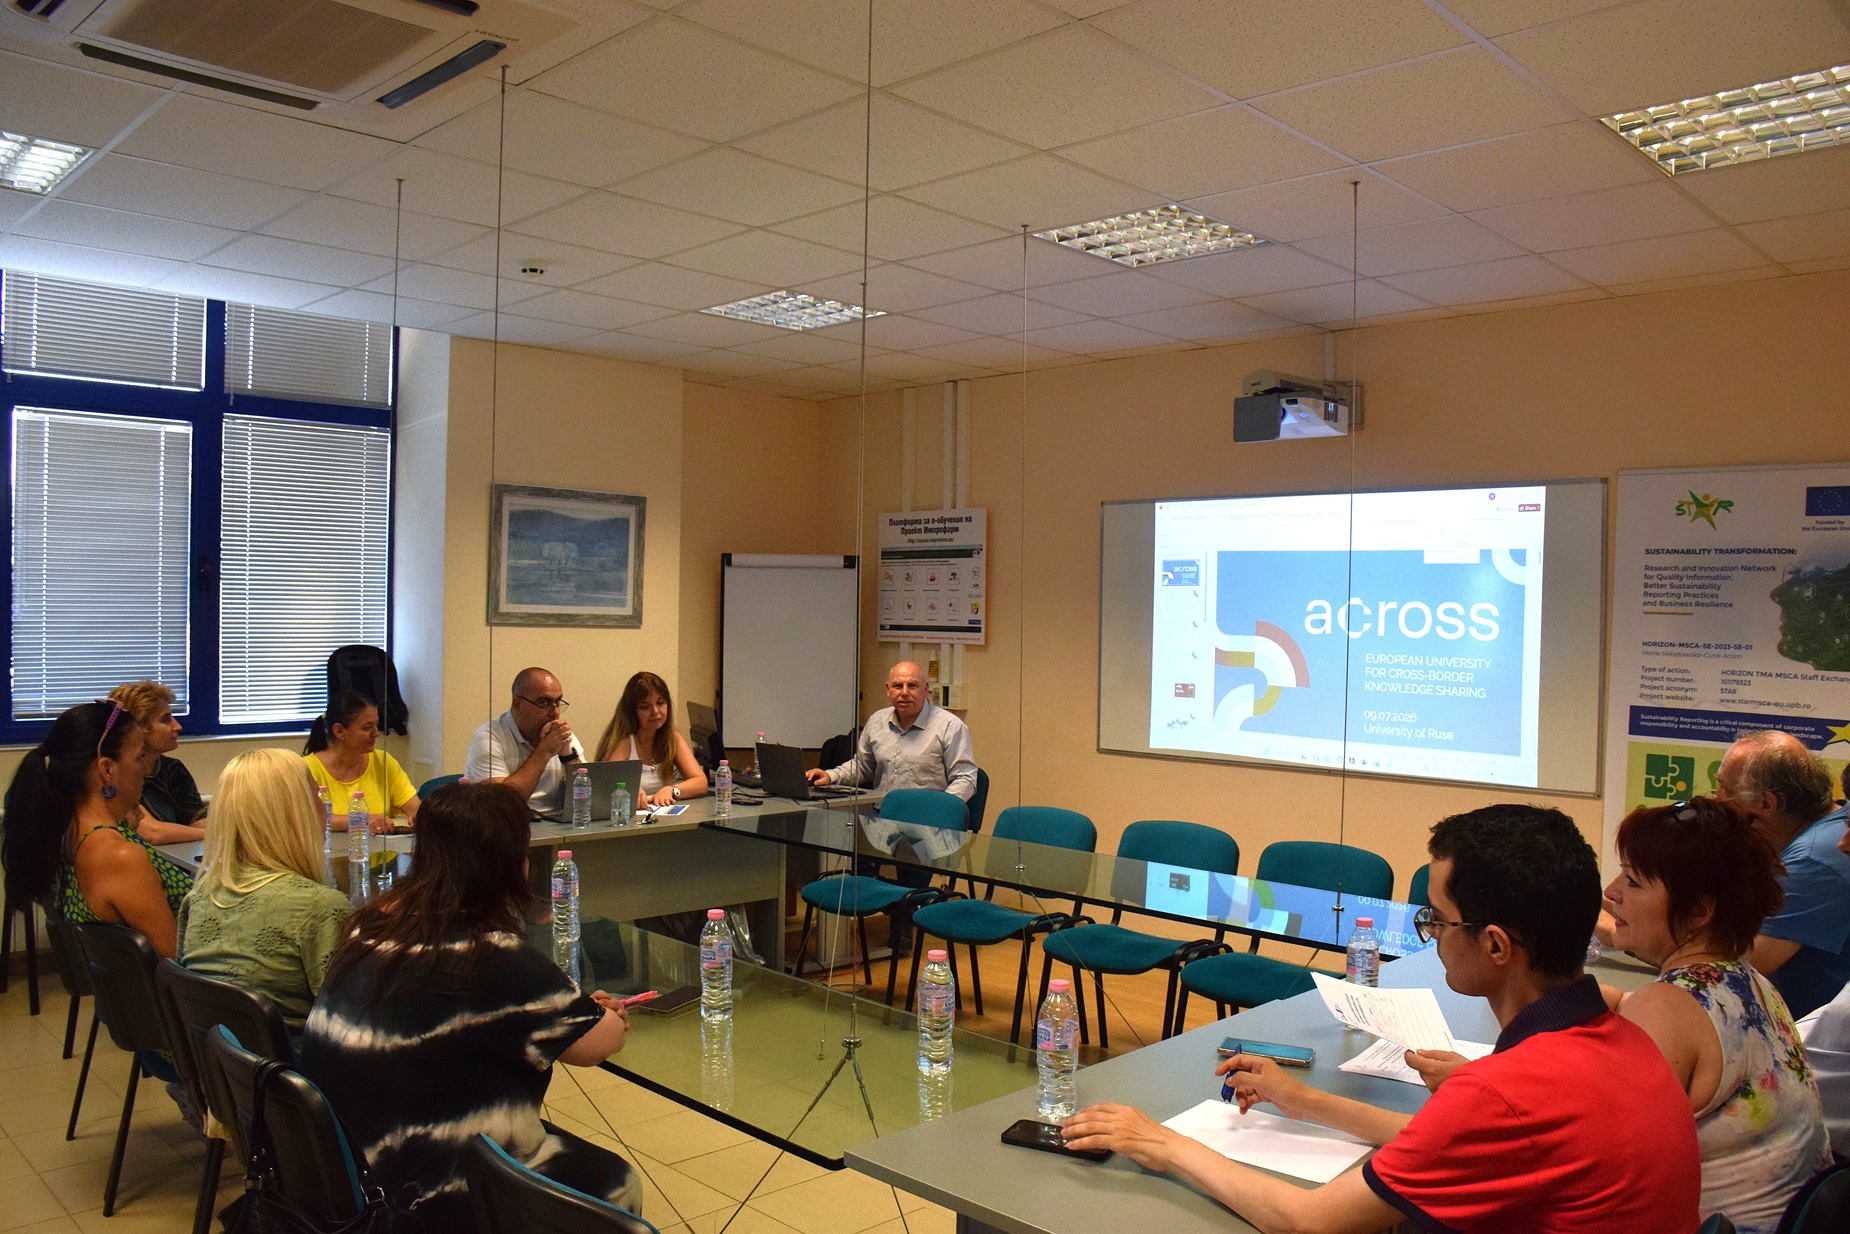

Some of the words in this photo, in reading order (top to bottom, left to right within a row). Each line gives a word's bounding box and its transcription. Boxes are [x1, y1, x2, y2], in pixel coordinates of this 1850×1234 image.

[1656, 574, 1683, 582] Quality
[1643, 591, 1681, 600] Reporting
[1304, 597, 1500, 641] across
[1642, 641, 1752, 650] HORIZON-MSCA-SE-2023-SE-01
[1365, 653, 1423, 666] EUROPEAN
[1426, 657, 1492, 670] UNIVERSITY
[1365, 667, 1386, 677] FOR
[1388, 668, 1474, 683] CROSS-BORDER
[1775, 672, 1798, 680] MSCA
[1364, 681, 1434, 695] KNOWLEDGE
[1436, 686, 1487, 698] SHARING
[1719, 698, 1811, 709] www.starmsca-eu.upb.ro
[1364, 710, 1417, 723] 09.07.2026
[1640, 714, 1678, 722] Sustainability
[1680, 716, 1709, 725] Reporting
[1738, 721, 1774, 729] component
[1364, 724, 1412, 739] University
[1415, 727, 1426, 738] of
[1428, 728, 1454, 740] Ruse
[1640, 720, 1678, 729] responsibility
[1691, 724, 1730, 732] accountability
